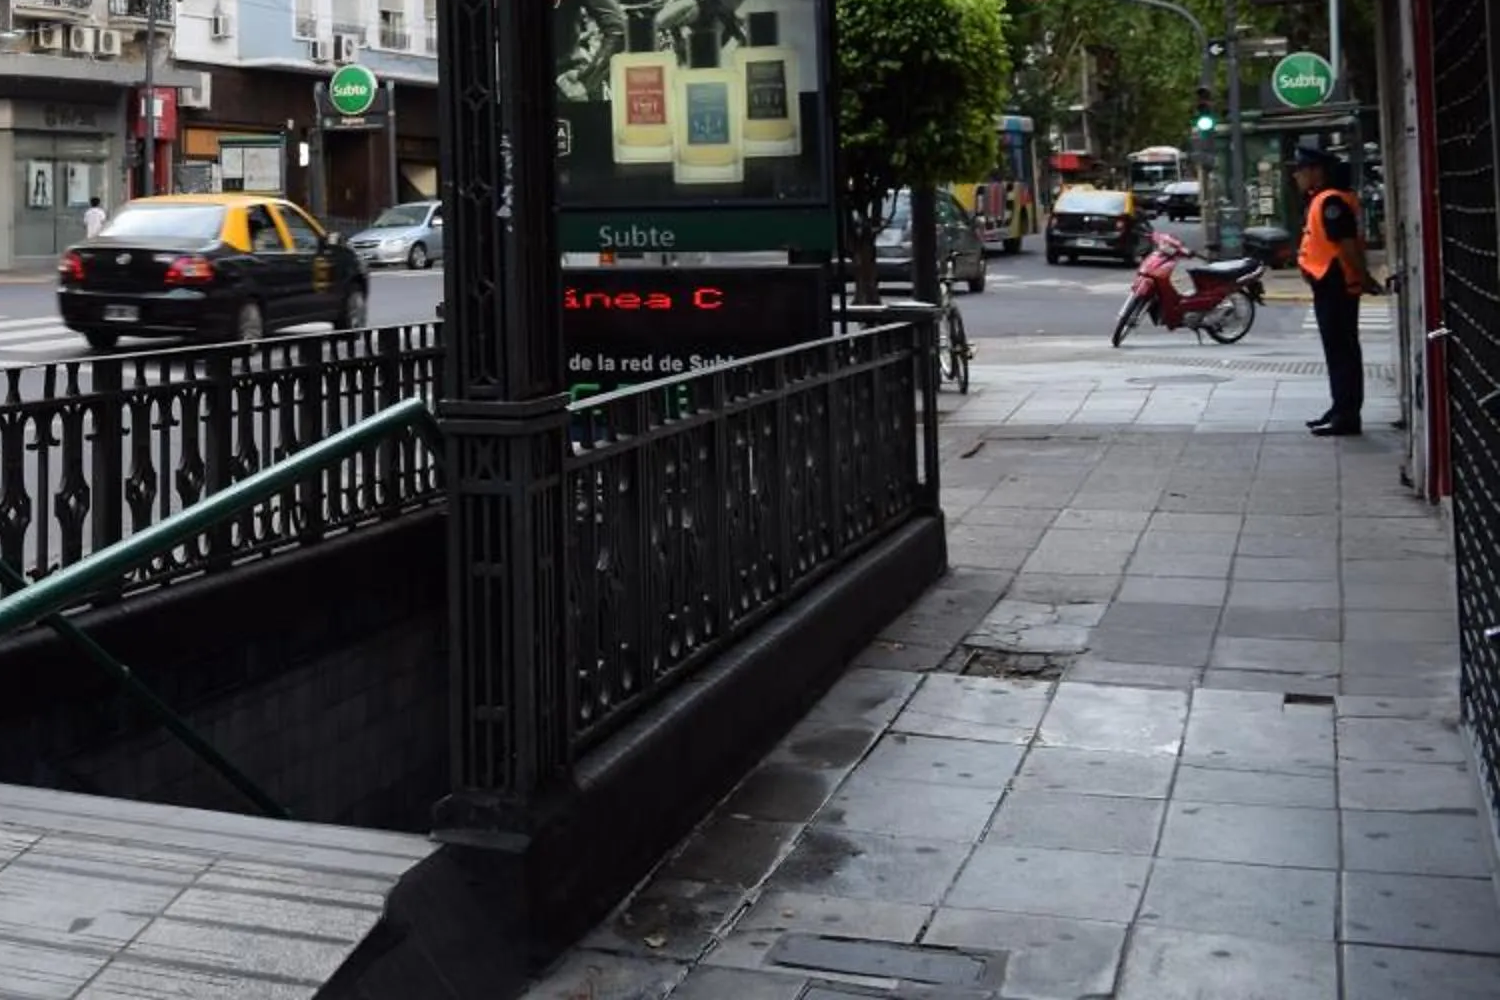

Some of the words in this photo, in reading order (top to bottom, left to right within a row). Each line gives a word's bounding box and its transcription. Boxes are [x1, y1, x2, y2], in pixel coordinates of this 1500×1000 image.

[599, 225, 676, 248] Subte
[694, 287, 724, 309] C
[569, 353, 593, 372] de
[598, 353, 615, 372] la
[622, 353, 653, 372] red
[659, 354, 684, 372] de
